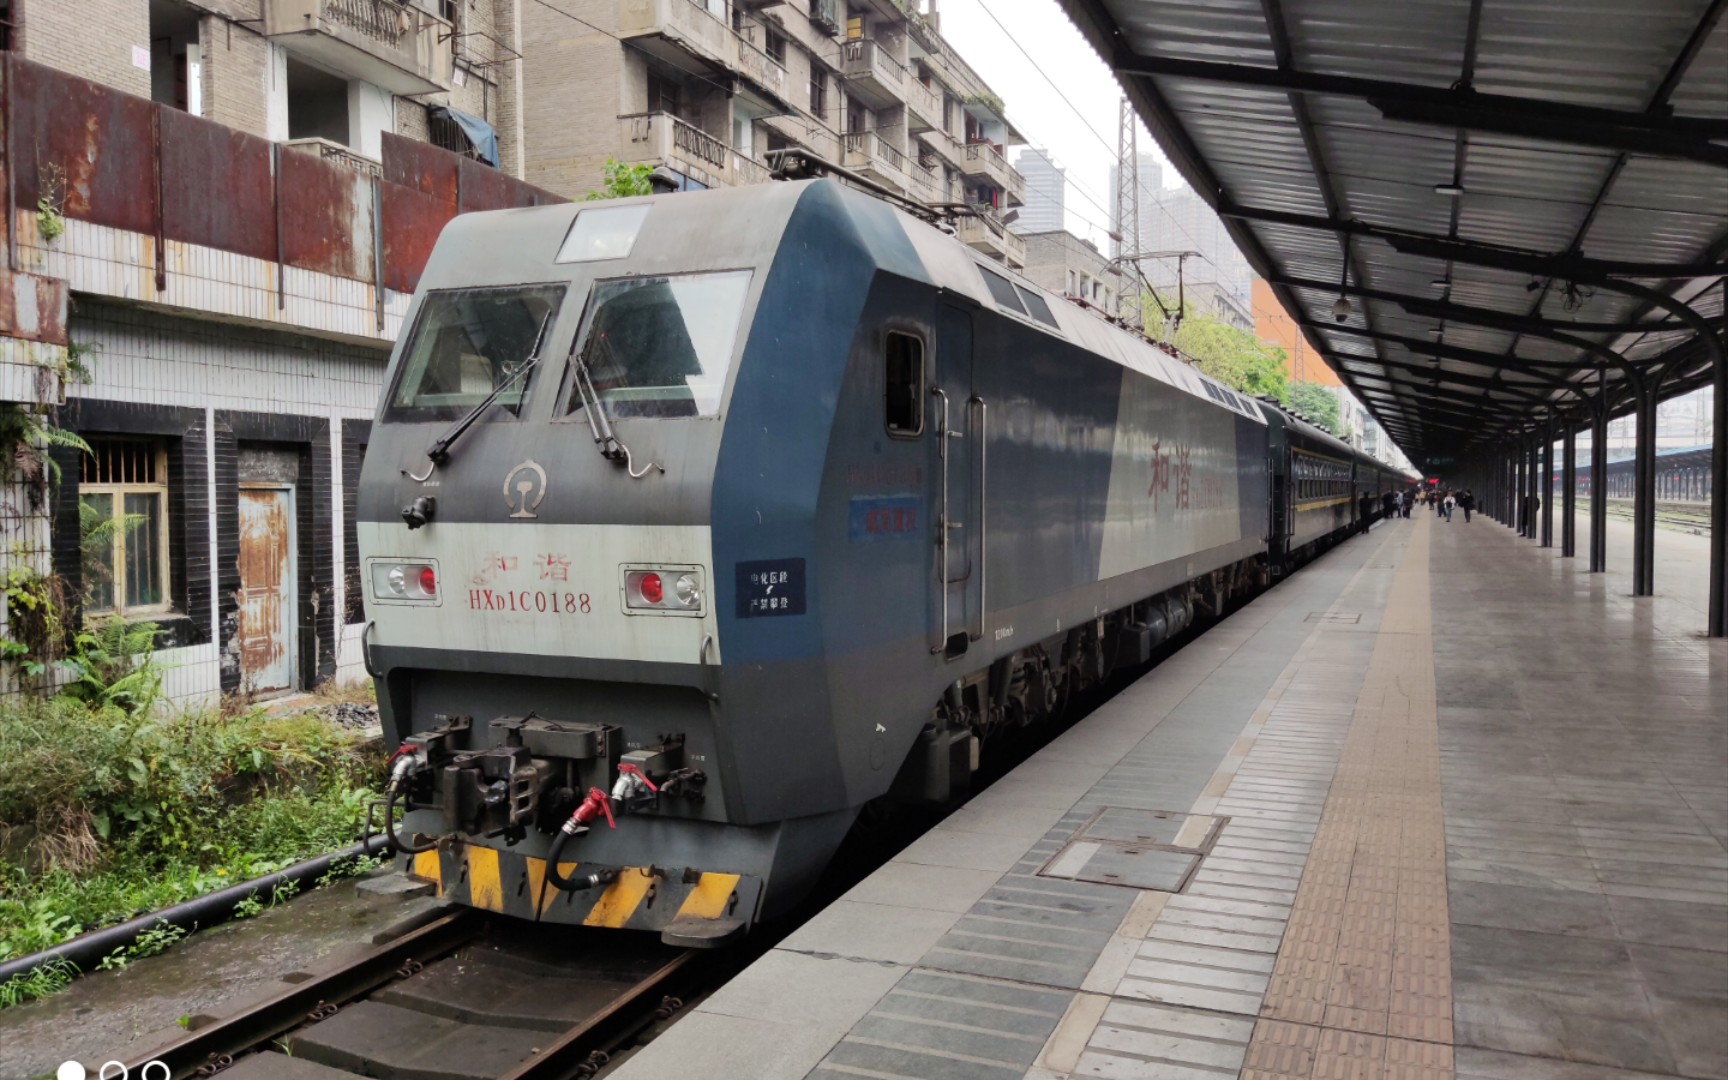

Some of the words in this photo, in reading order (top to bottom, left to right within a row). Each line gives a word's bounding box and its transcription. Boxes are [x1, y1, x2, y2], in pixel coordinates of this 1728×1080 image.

[1148, 441, 1192, 512] 和谐
[482, 553, 572, 581] 和谐
[750, 571, 788, 585] 电化区段
[750, 597, 788, 612] 严禁攀登
